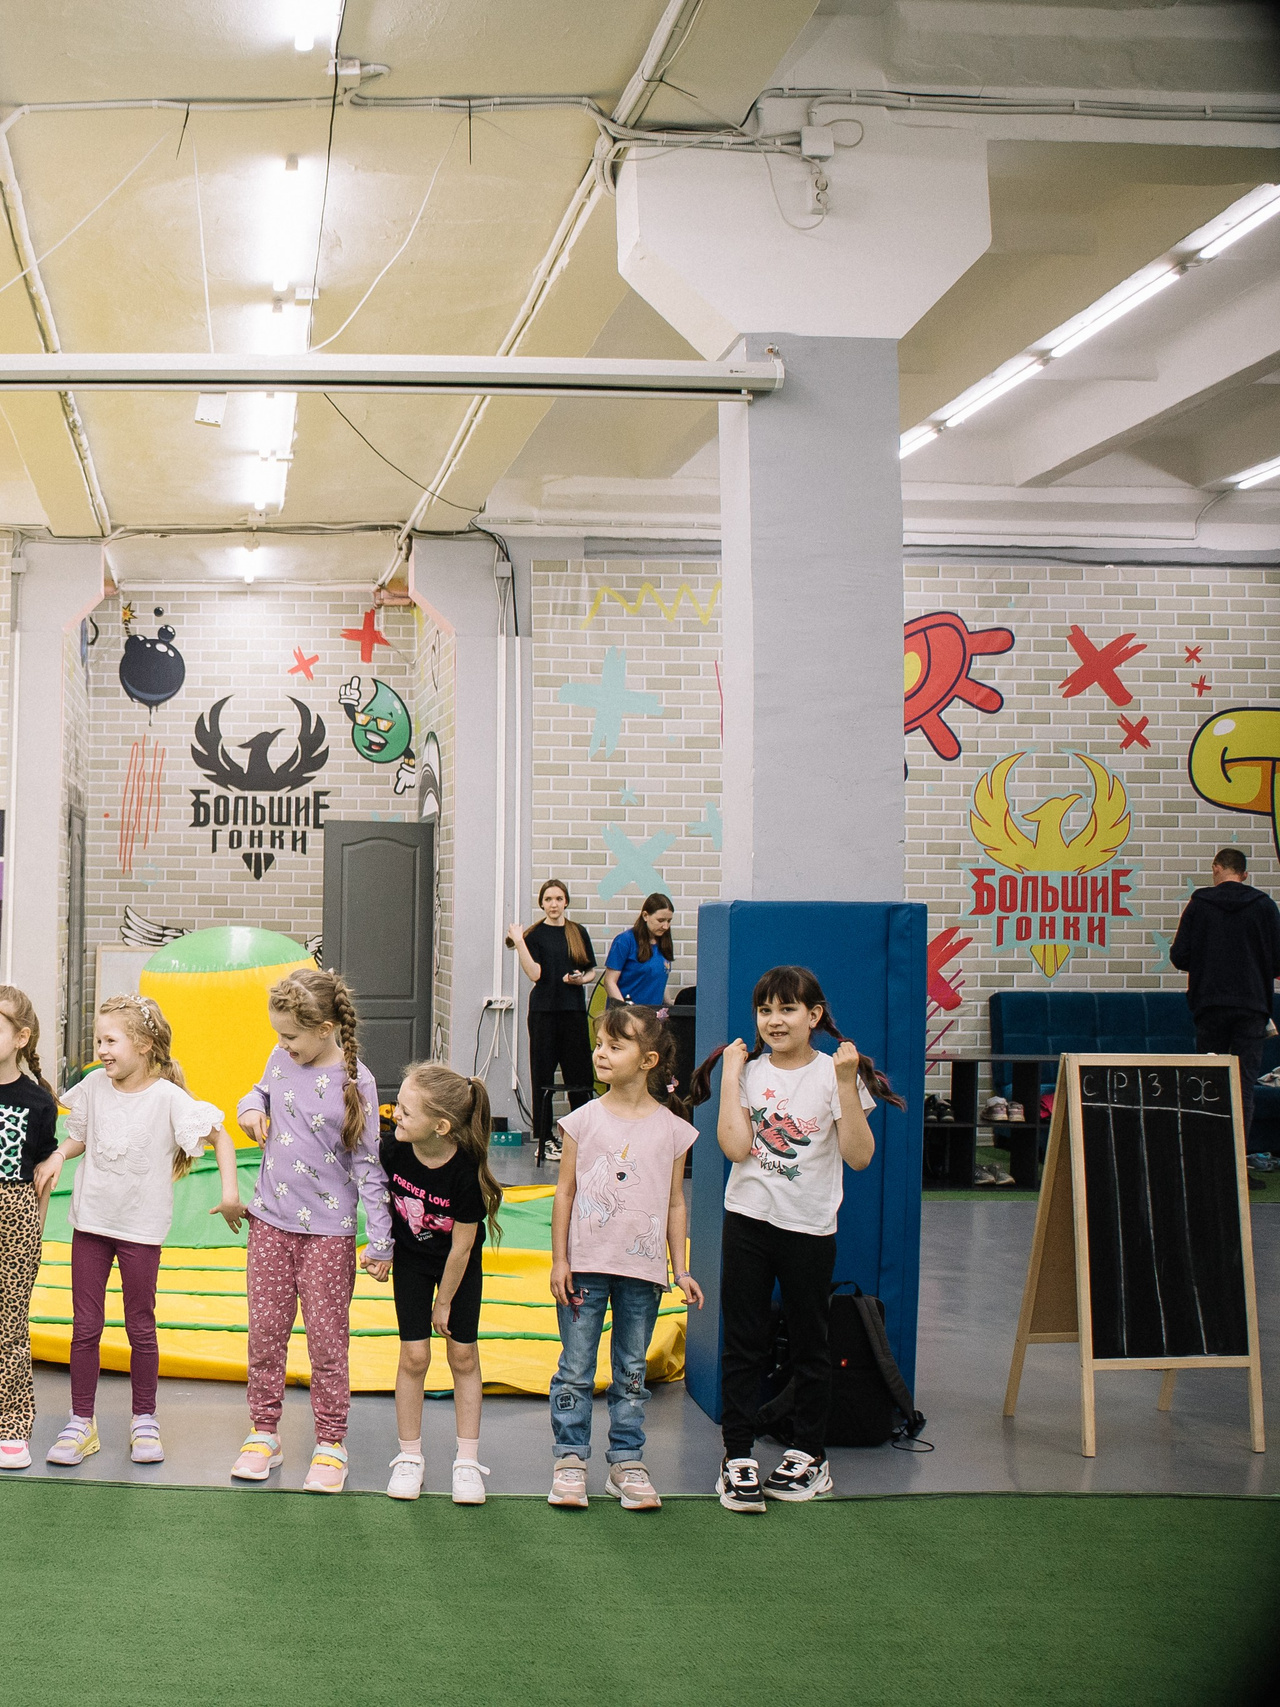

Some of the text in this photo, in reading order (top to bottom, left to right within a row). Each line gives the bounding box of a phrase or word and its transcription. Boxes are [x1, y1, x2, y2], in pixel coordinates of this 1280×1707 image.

[188, 789, 331, 829] БОЛЬШИЕ
[211, 829, 307, 855] ГОНКИ
[968, 868, 1133, 916] БОЛЬШИЕ
[996, 916, 1106, 947] ГОНКИ
[392, 1173, 451, 1207] FOREVER LOVE
